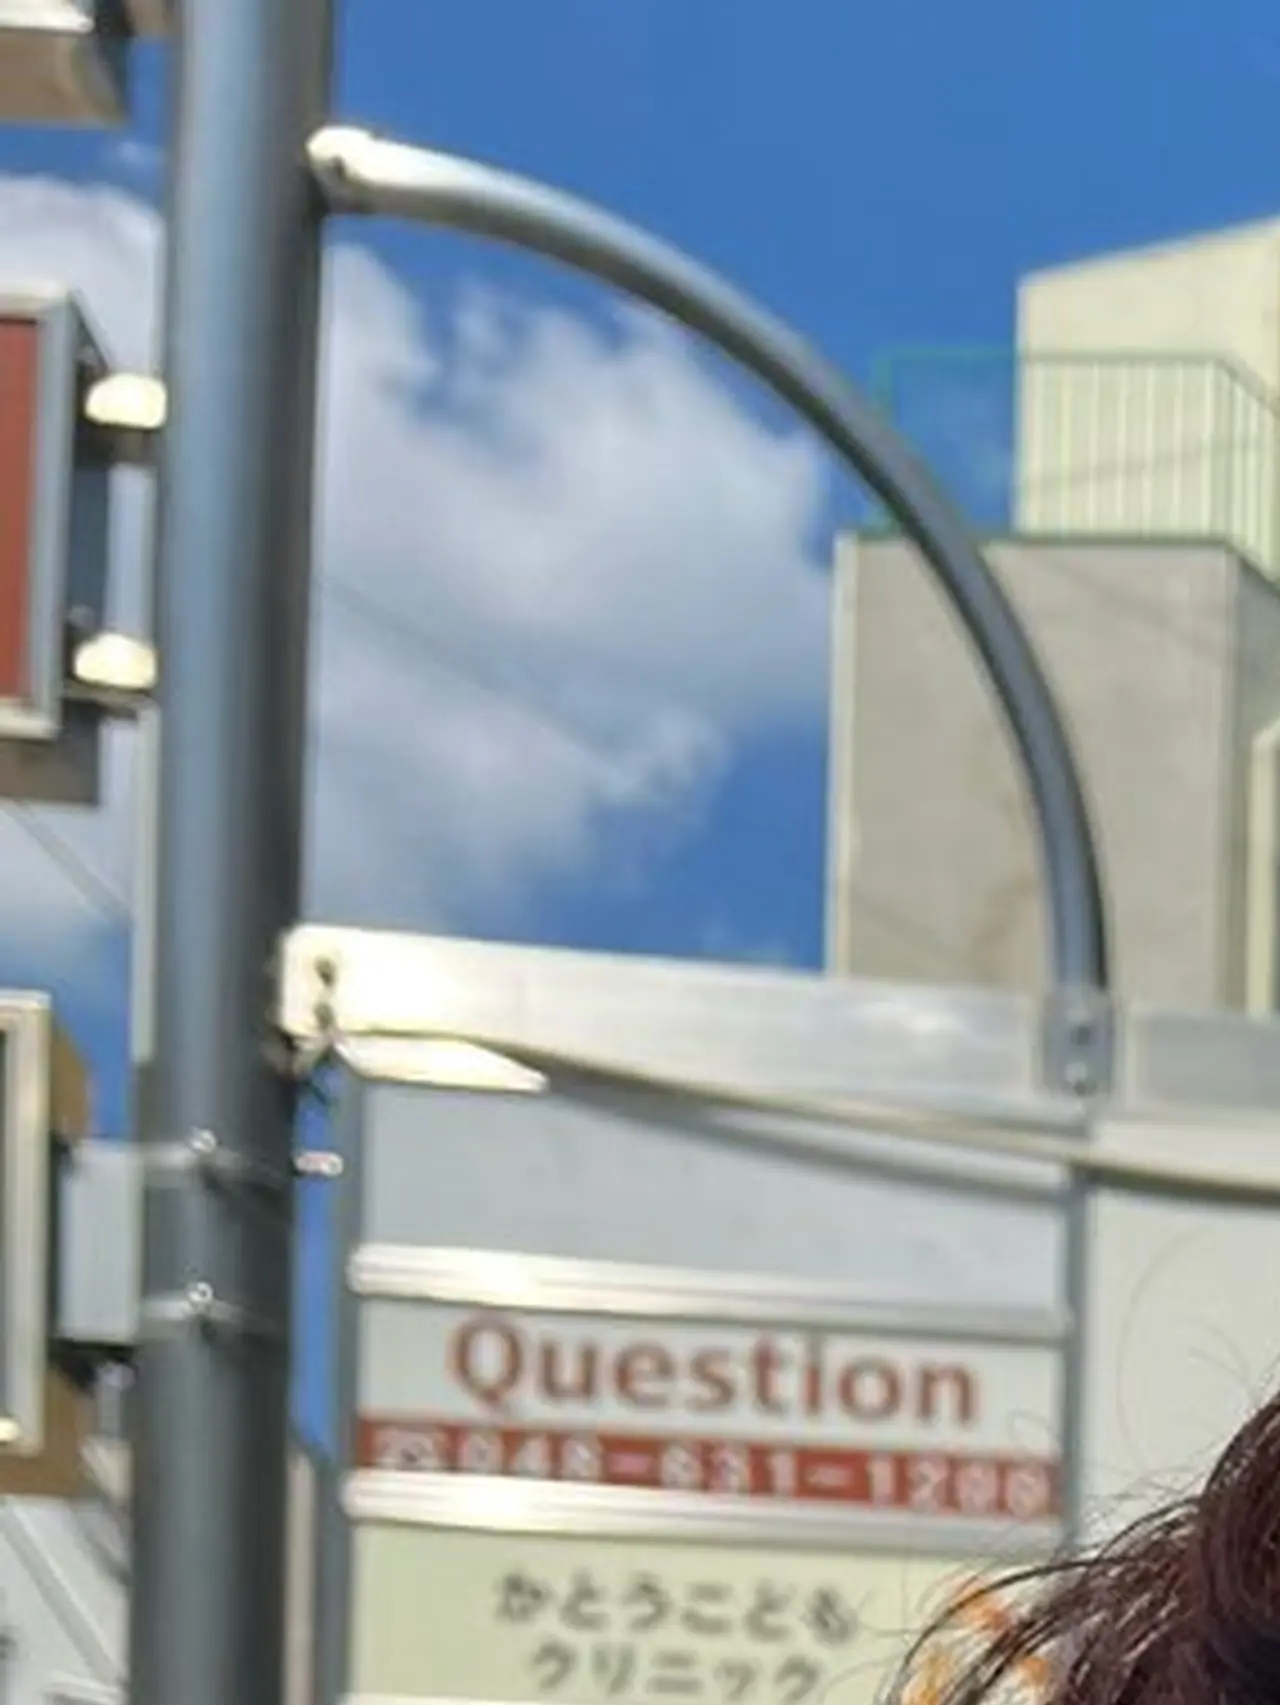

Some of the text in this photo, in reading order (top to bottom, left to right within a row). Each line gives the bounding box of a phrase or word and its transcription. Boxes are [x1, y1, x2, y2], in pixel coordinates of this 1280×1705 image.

[446, 1311, 980, 1427] Question
[495, 1564, 859, 1649] かとうこども
